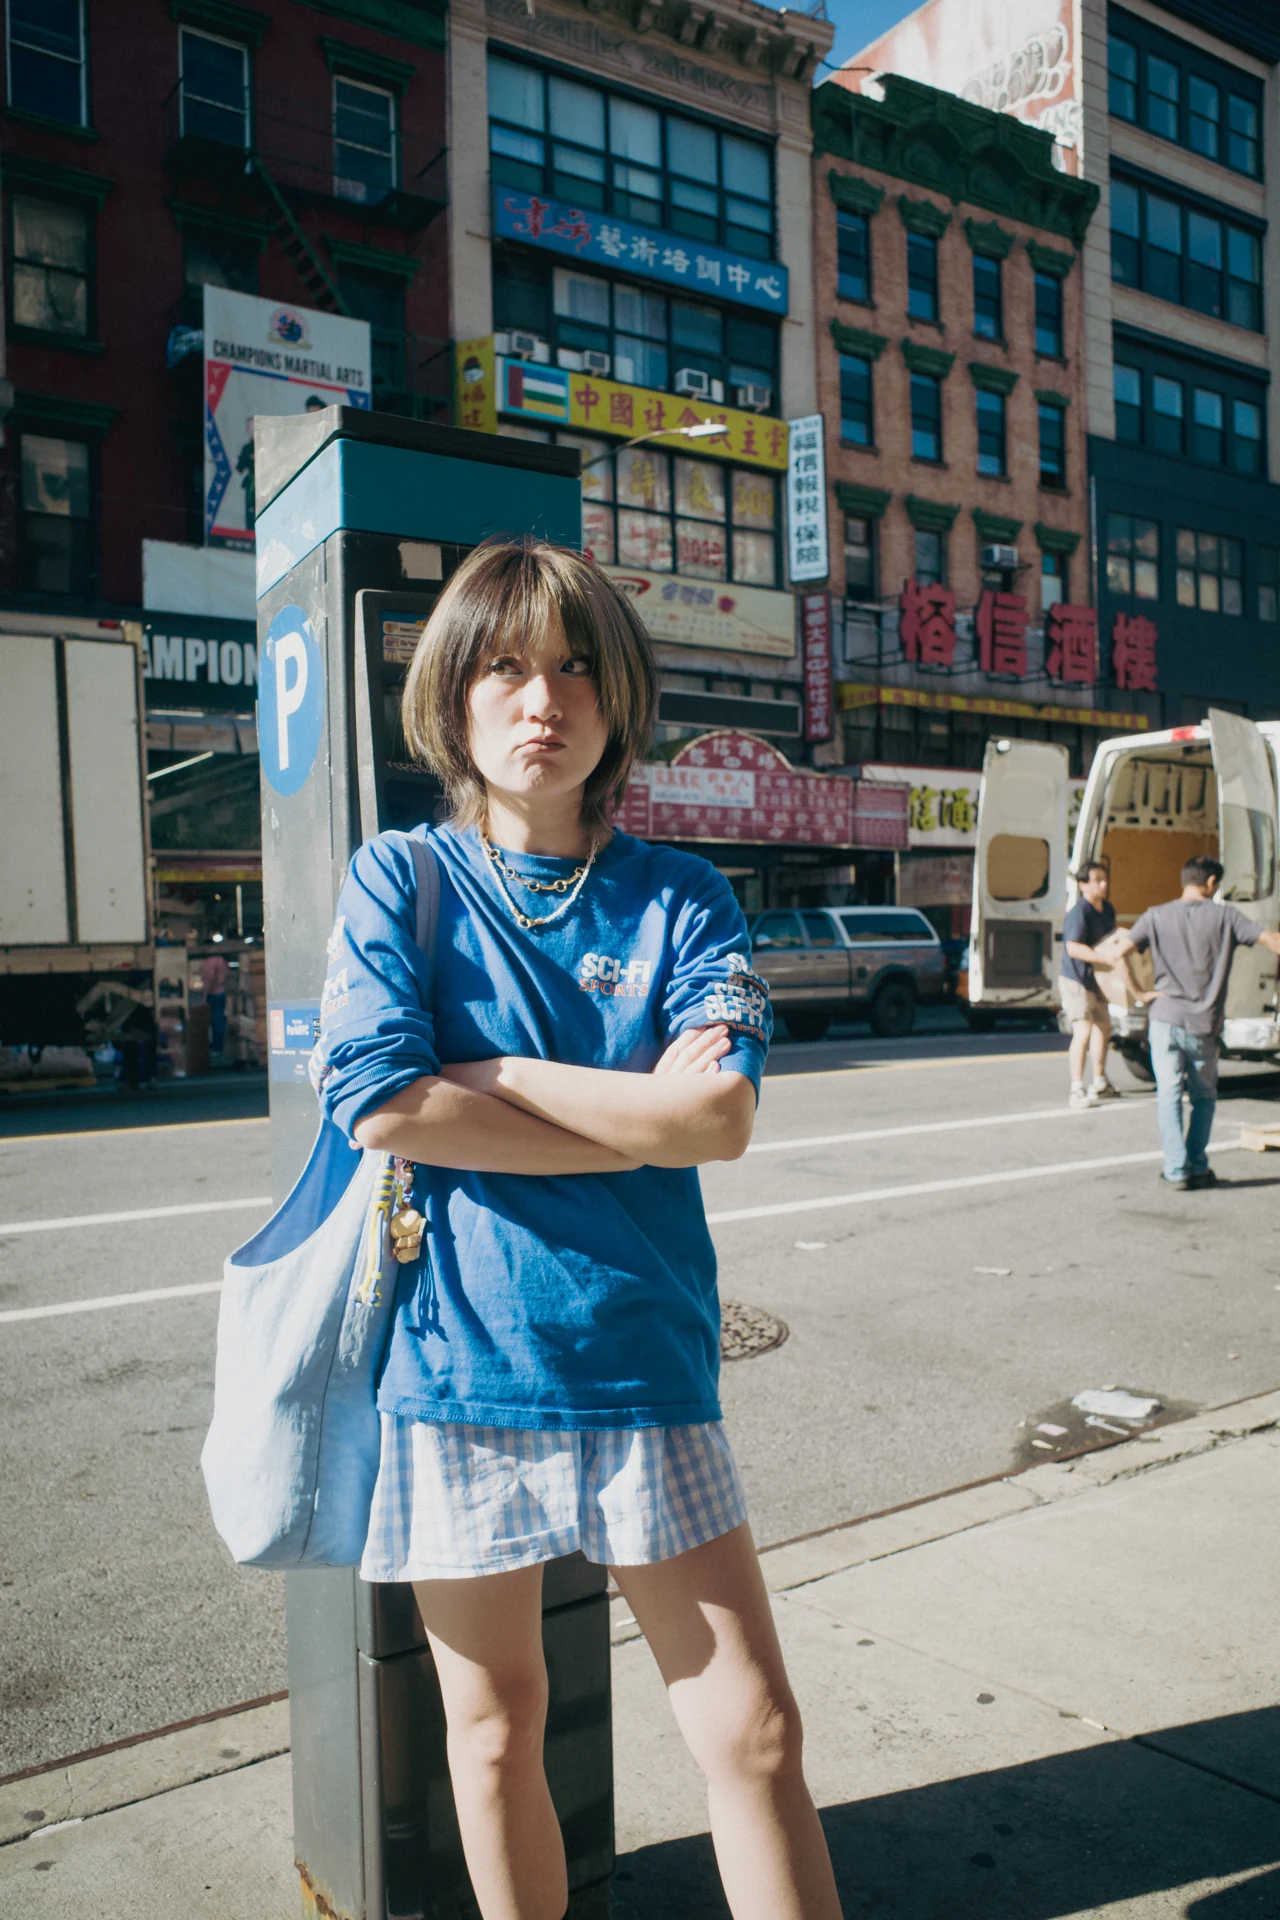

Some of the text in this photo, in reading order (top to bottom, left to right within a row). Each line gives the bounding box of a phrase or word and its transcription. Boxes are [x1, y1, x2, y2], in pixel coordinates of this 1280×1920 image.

[213, 339, 282, 371] CHAMPIONS
[285, 355, 332, 382] MARTIAL
[336, 366, 364, 387] ARTS
[275, 631, 308, 771] P
[909, 785, 979, 832] 信酒
[579, 977, 649, 997] SPORTS
[581, 952, 651, 984] SCI-FI
